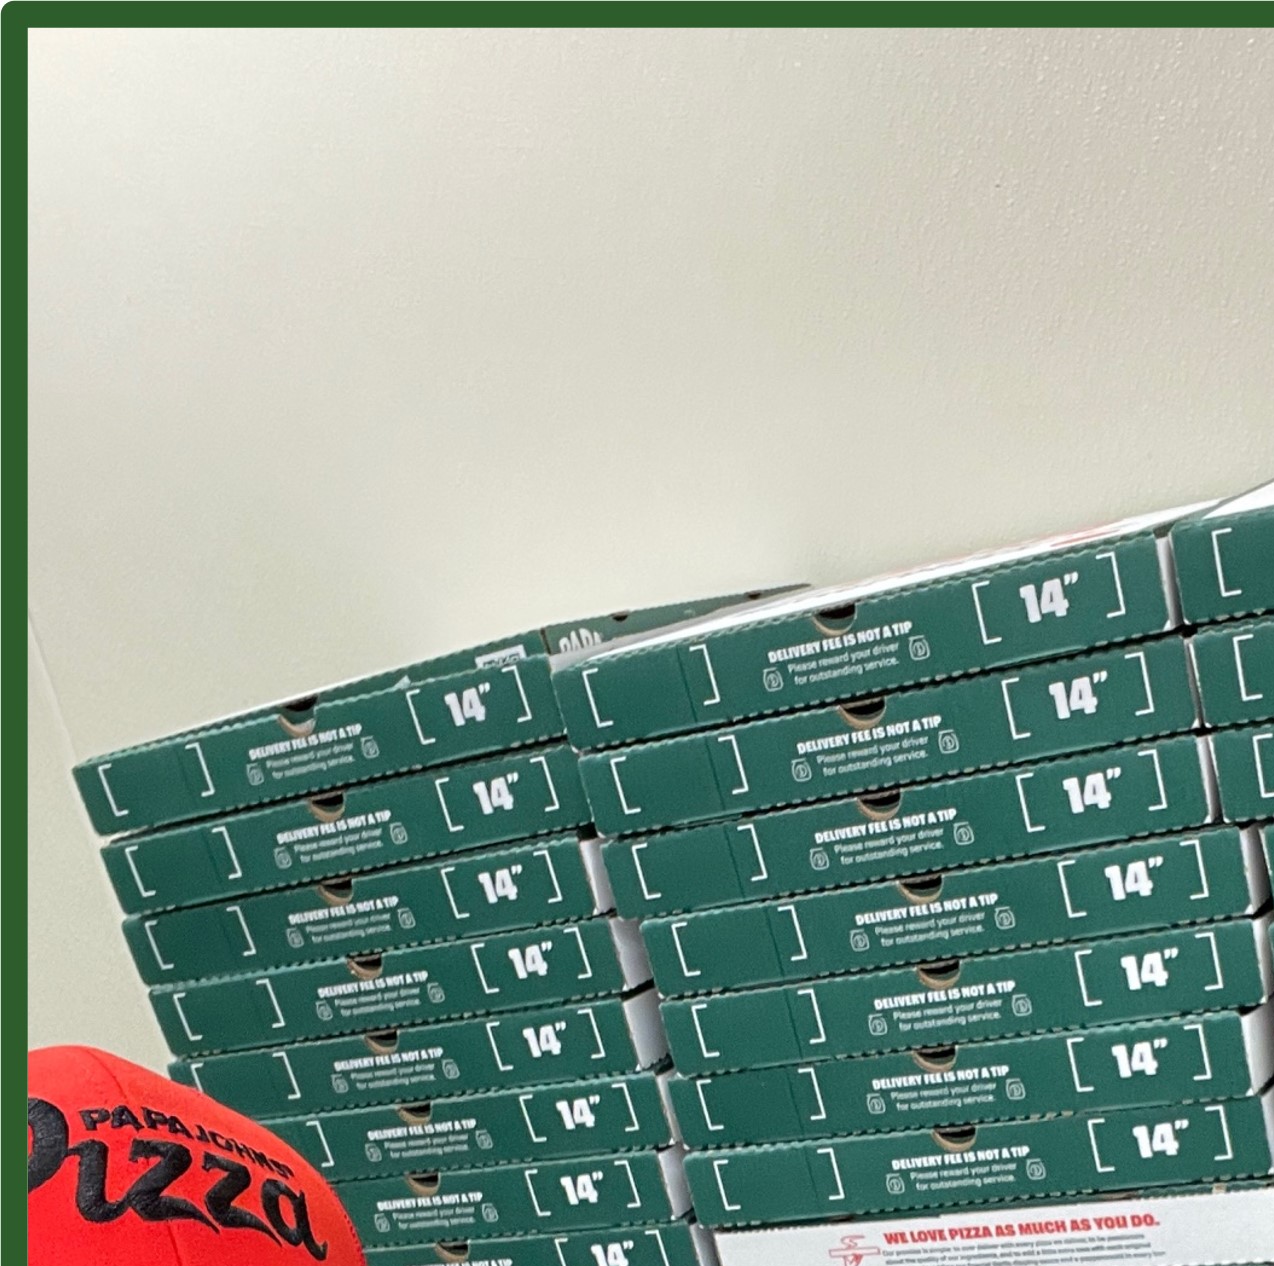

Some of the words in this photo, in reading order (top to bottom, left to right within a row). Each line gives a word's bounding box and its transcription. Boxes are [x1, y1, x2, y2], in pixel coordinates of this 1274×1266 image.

[1020, 572, 1078, 623] 14"
[767, 641, 820, 663] DELIVERY
[821, 636, 842, 651] FEE
[842, 633, 856, 646] IS
[856, 627, 880, 643] NOT
[882, 625, 892, 638] A
[891, 621, 912, 636] TIP
[445, 683, 490, 726] 14"
[1049, 671, 1107, 719] 14"
[473, 772, 518, 814] 14"
[1063, 767, 1121, 813] 14"
[478, 865, 522, 903] 14"
[1105, 856, 1163, 900] 14"
[508, 941, 552, 979] 14"
[1121, 948, 1178, 990] 14"
[523, 1022, 566, 1057] 14"
[1112, 1038, 1167, 1077] 14"
[78, 1104, 193, 1140] PAPA
[556, 1095, 600, 1129] 14"
[1133, 1119, 1188, 1158] 14"
[561, 1171, 603, 1204] 14"
[884, 1232, 908, 1244] WE
[910, 1229, 946, 1242] LOVE
[948, 1226, 992, 1239] PIZZA
[994, 1223, 1016, 1237] AS
[1017, 1220, 1067, 1235] MUCH
[1069, 1218, 1091, 1231] AS
[1094, 1215, 1128, 1229] YOU
[1130, 1213, 1160, 1227] DO.
